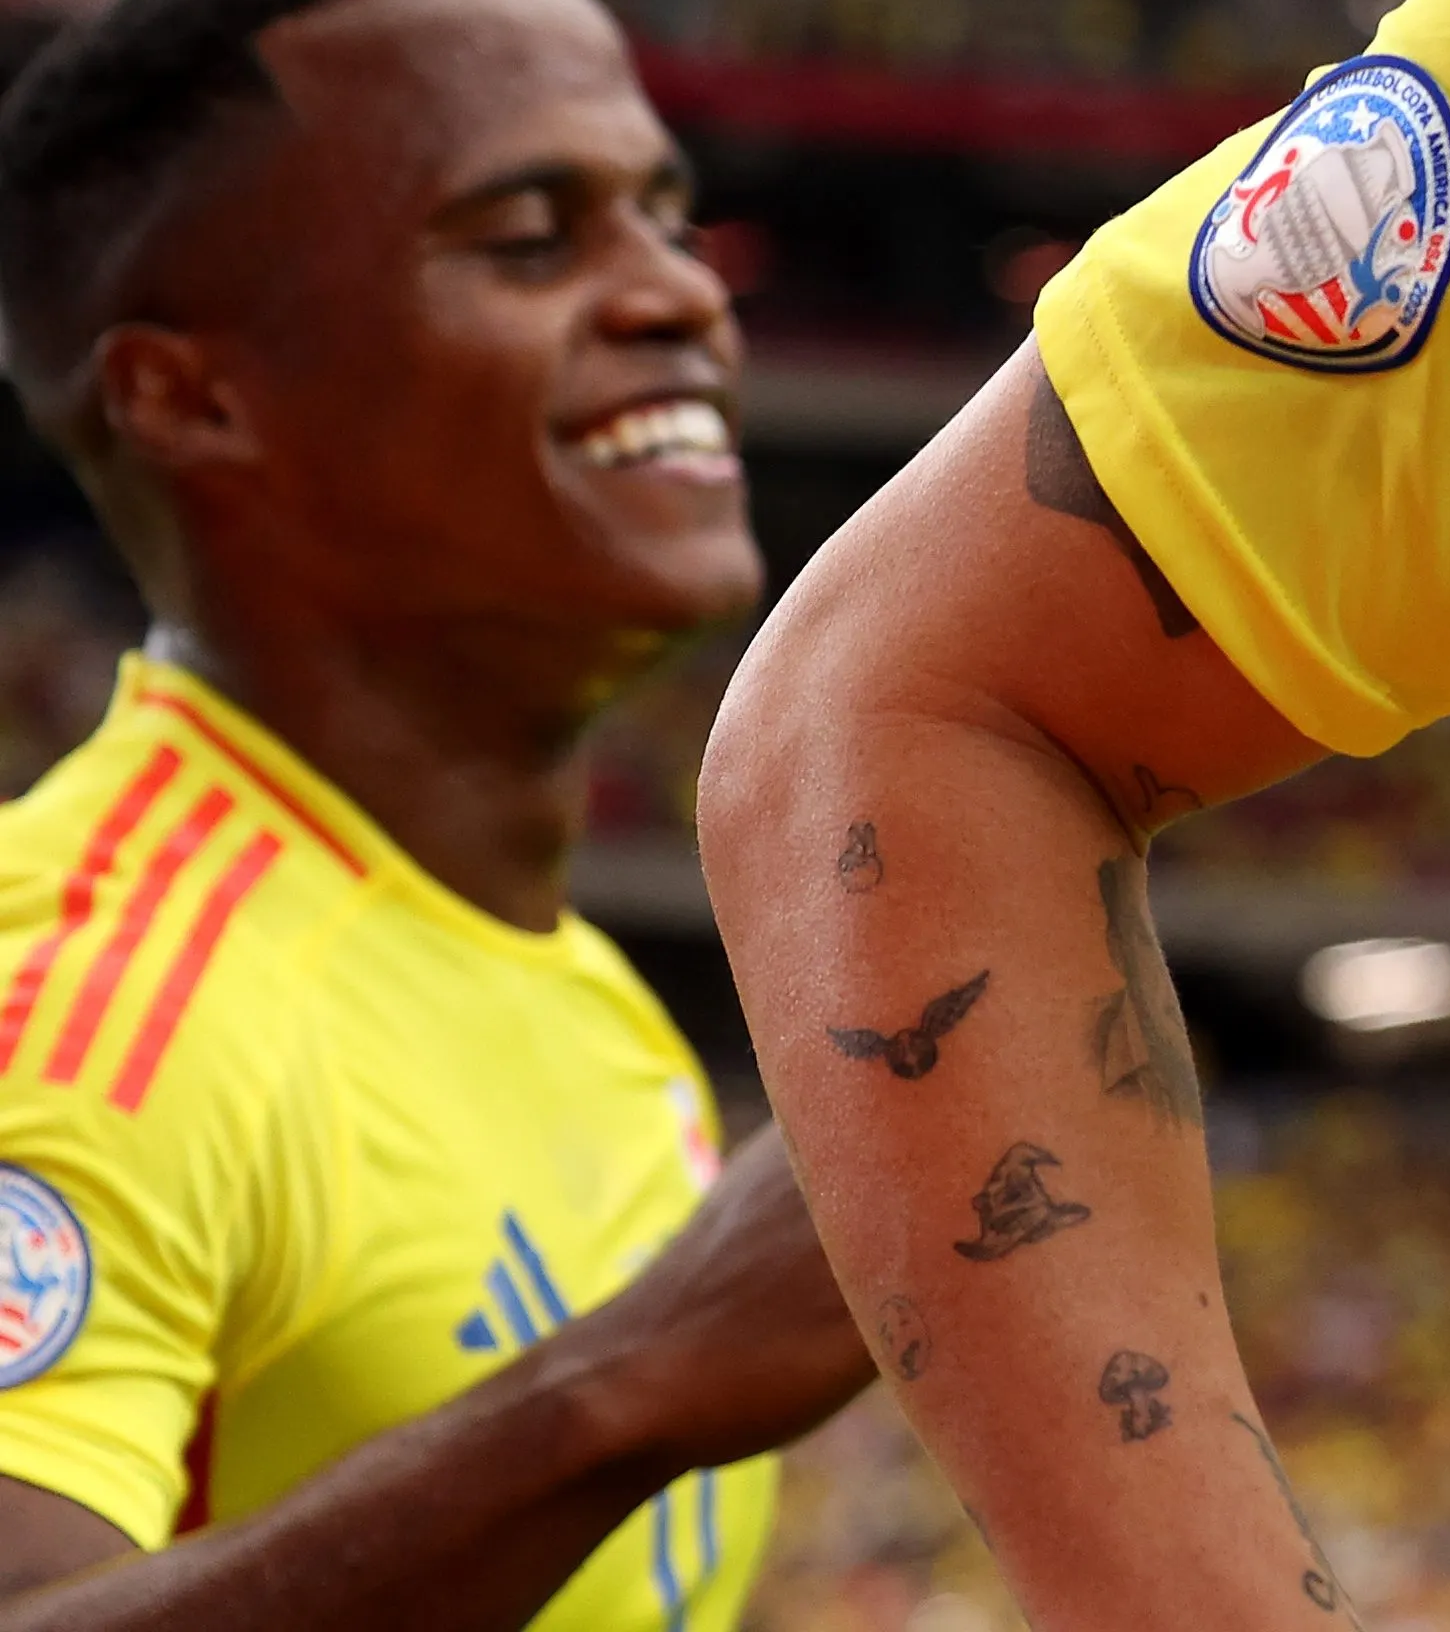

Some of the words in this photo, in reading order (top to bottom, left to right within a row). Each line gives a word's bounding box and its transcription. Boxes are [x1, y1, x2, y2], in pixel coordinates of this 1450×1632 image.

[1316, 67, 1401, 101] CONMEBOL
[1401, 85, 1434, 129] COPA
[1420, 233, 1445, 272] USA
